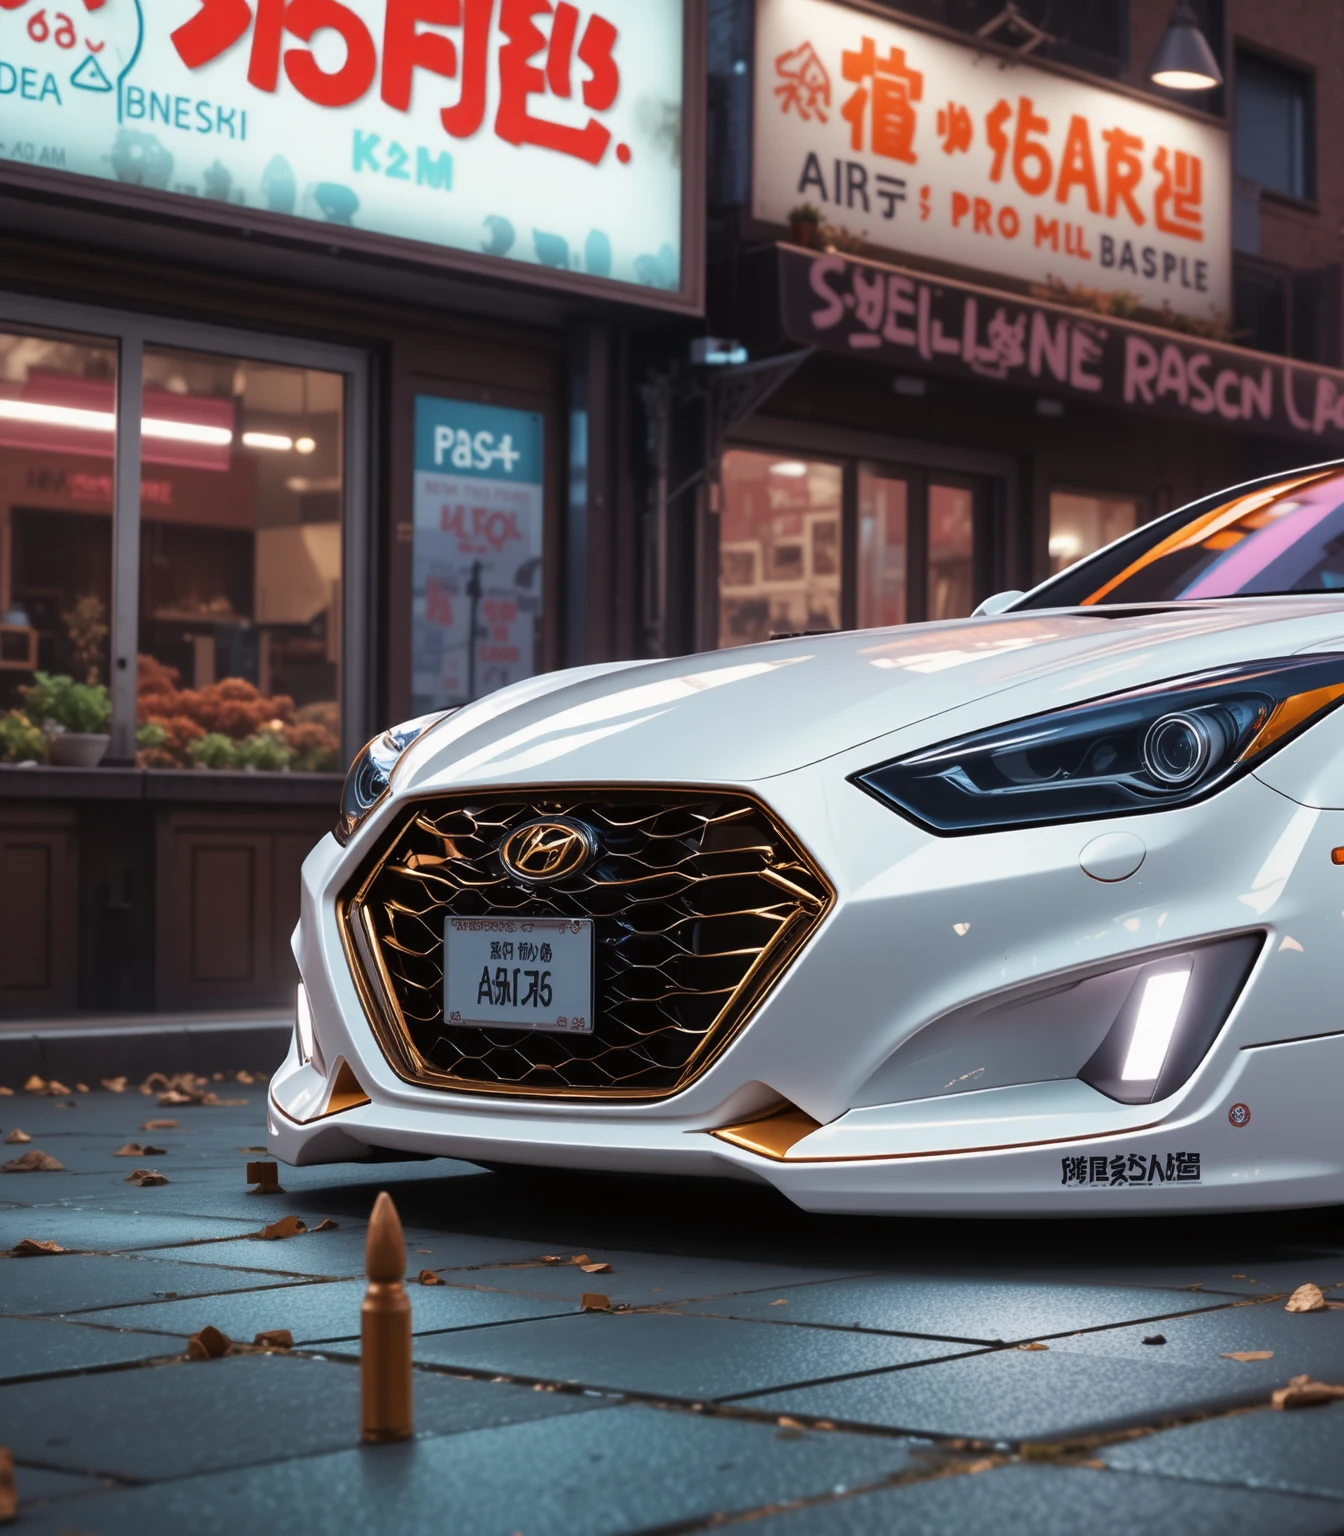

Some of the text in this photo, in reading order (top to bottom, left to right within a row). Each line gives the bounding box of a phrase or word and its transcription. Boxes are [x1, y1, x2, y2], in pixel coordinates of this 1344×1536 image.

[126, 85, 247, 141] BNESKI
[352, 128, 454, 191] K2M
[952, 191, 1020, 240] PRO
[1100, 233, 1208, 292] BASPLE
